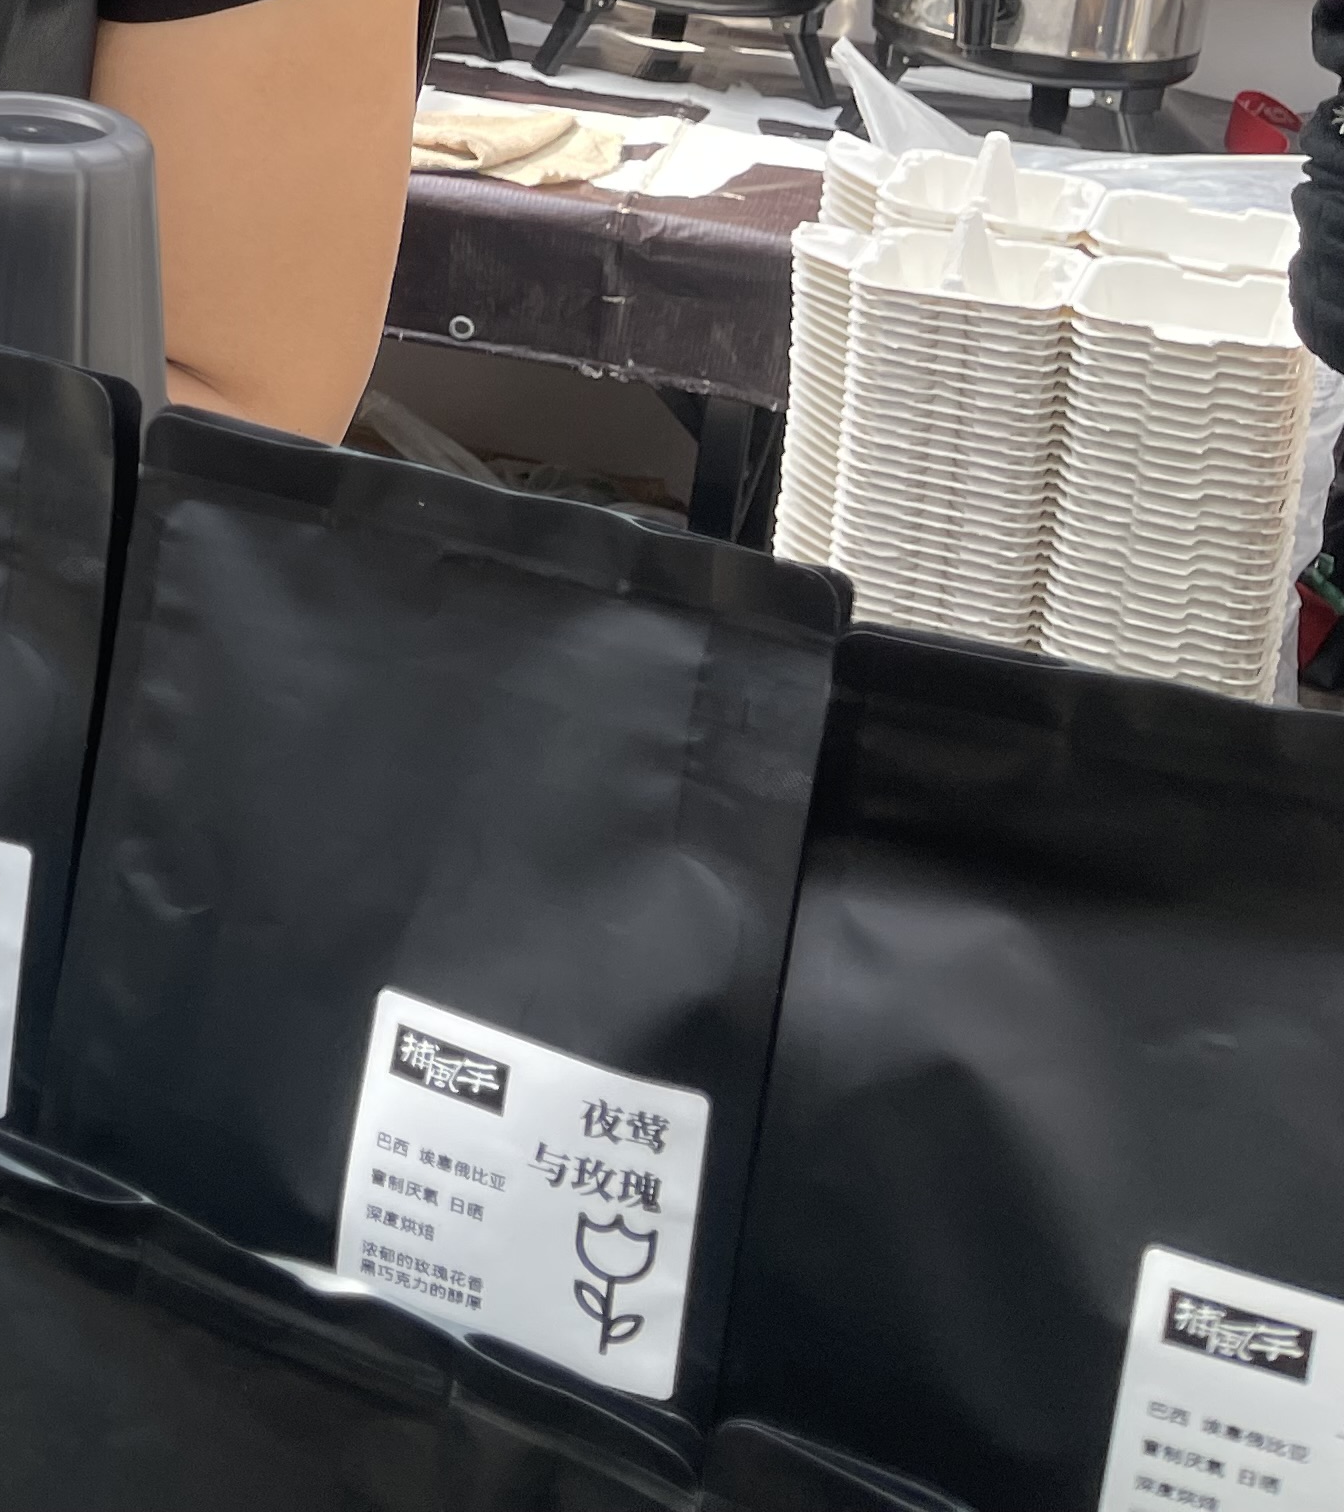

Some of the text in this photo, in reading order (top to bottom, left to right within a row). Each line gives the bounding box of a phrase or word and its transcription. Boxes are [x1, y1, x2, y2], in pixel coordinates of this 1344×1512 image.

[580, 1098, 671, 1155] 夜莺
[376, 1131, 506, 1193] 巴西 埃塞俄比亚
[527, 1142, 664, 1215] 与玫瑰
[365, 1203, 435, 1242] 深度烘焙
[450, 1196, 484, 1223] 日晒
[360, 1257, 483, 1311] 黑巧克力的醇厚
[361, 1239, 484, 1293] 浓郁的玫瑰花香
